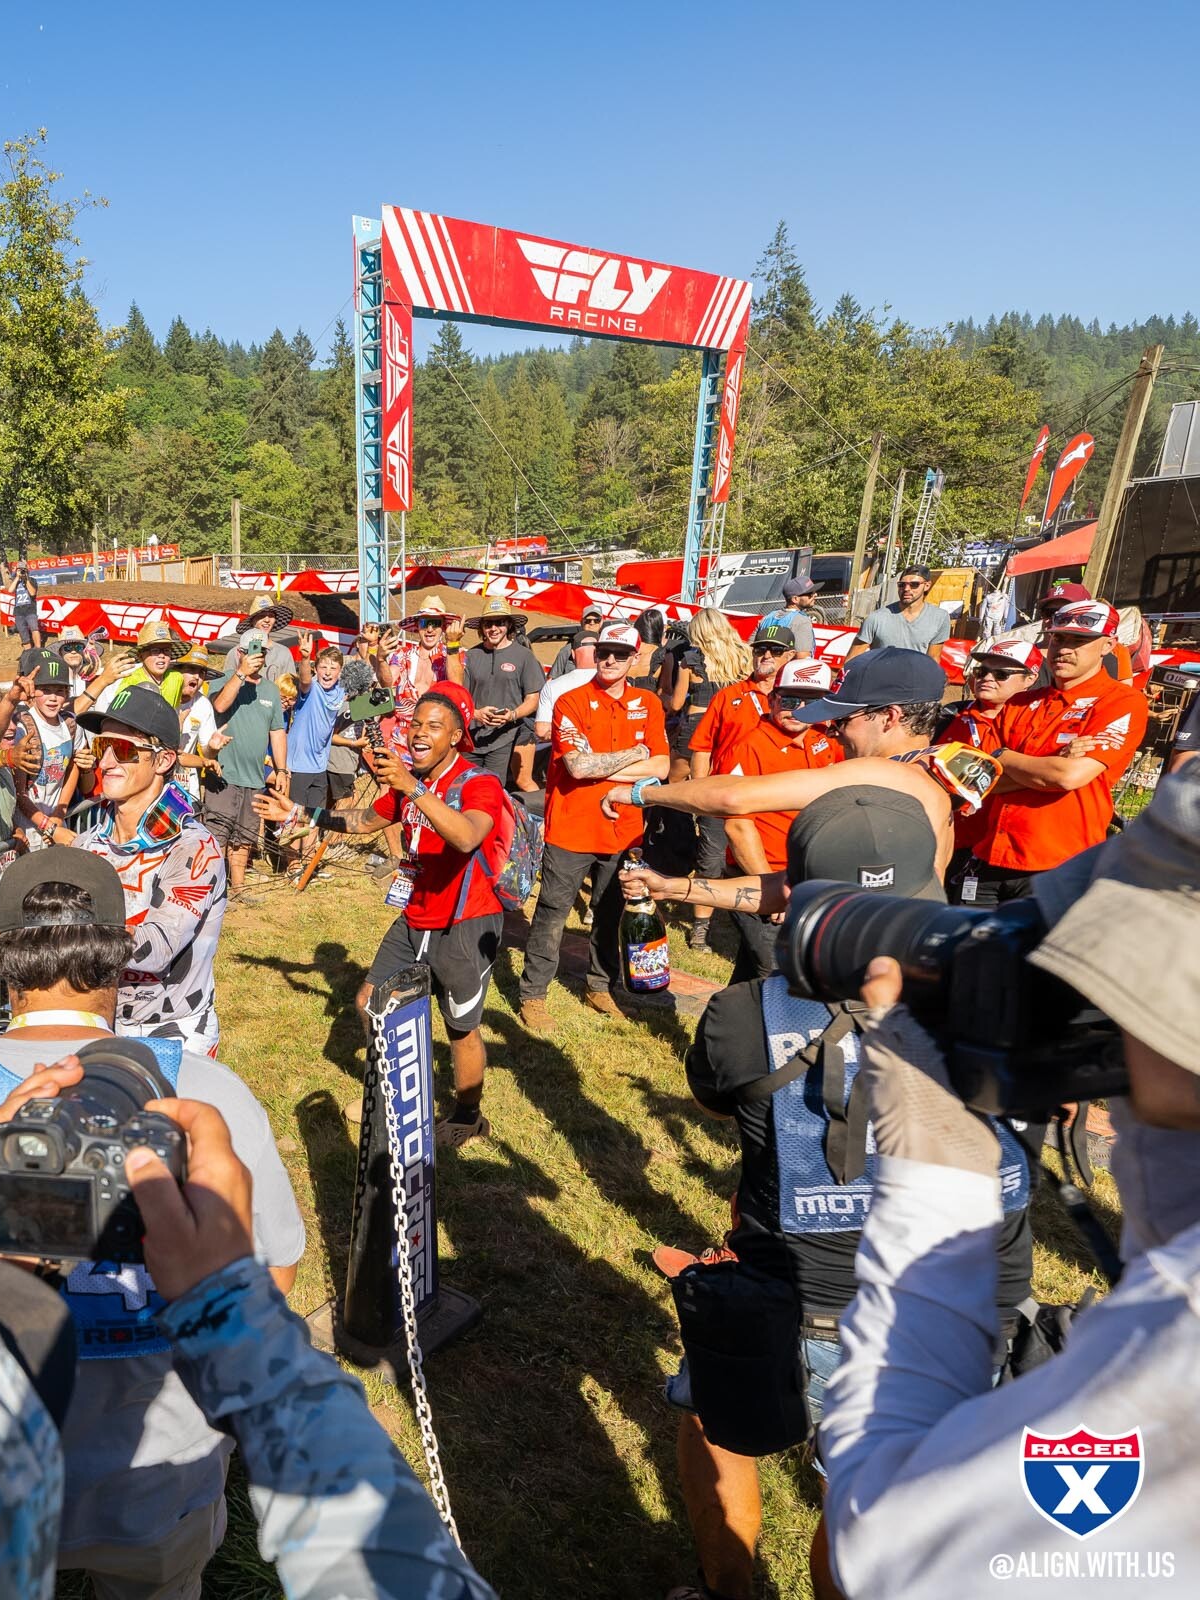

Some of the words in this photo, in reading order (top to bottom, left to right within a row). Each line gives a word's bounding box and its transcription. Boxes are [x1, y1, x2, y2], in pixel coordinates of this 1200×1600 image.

[516, 238, 672, 315] FLY
[550, 306, 637, 332] RACING
[709, 565, 789, 579] apinestars
[17, 593, 30, 604] 22
[167, 896, 202, 919] HONDA
[397, 1017, 424, 1303] MOTOCROSS
